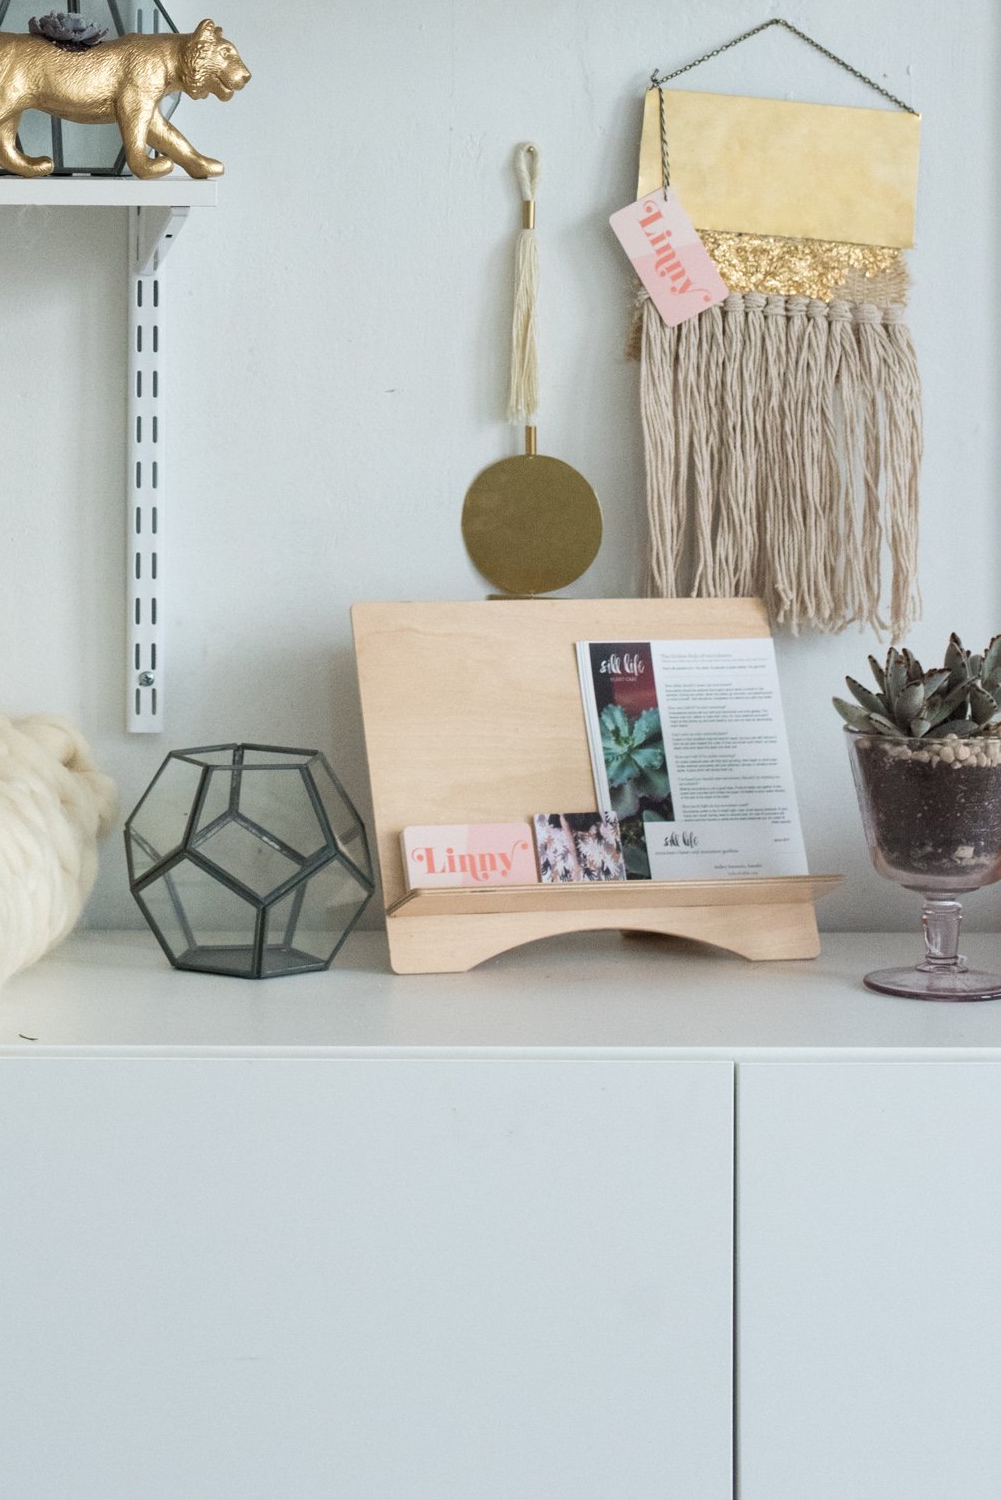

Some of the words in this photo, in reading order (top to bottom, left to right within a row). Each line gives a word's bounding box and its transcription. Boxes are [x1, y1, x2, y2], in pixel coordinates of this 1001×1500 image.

[638, 200, 711, 302] Linny
[623, 653, 645, 676] life
[411, 839, 529, 882] Linny
